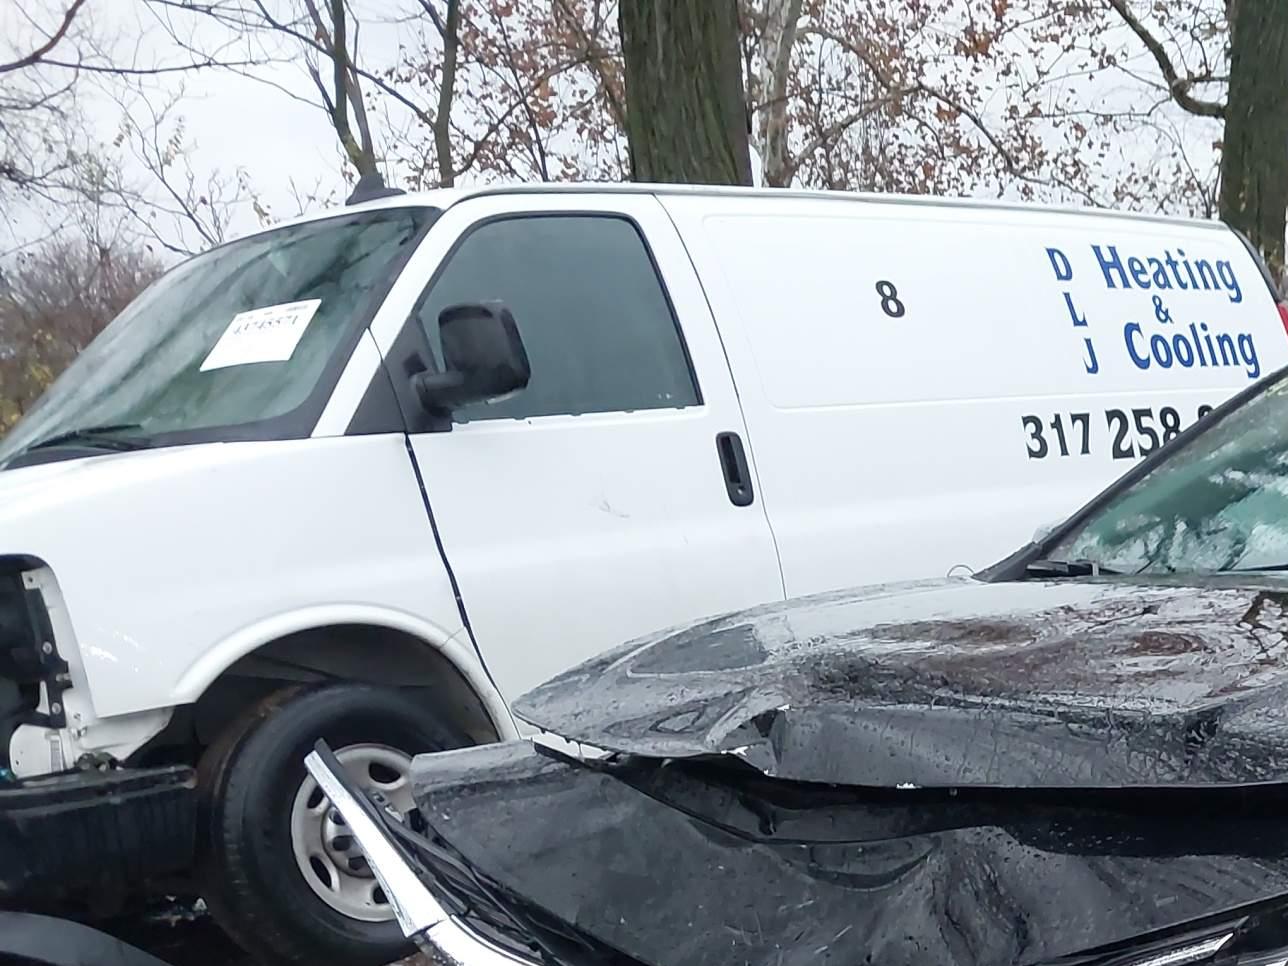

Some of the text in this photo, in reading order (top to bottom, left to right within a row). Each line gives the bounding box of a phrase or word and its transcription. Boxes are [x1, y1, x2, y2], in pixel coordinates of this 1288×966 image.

[875, 280, 905, 318] 8
[1091, 244, 1243, 304] Heating
[1151, 295, 1173, 324] &
[1123, 322, 1261, 379] Cooling
[1021, 406, 1181, 459] 317 258
